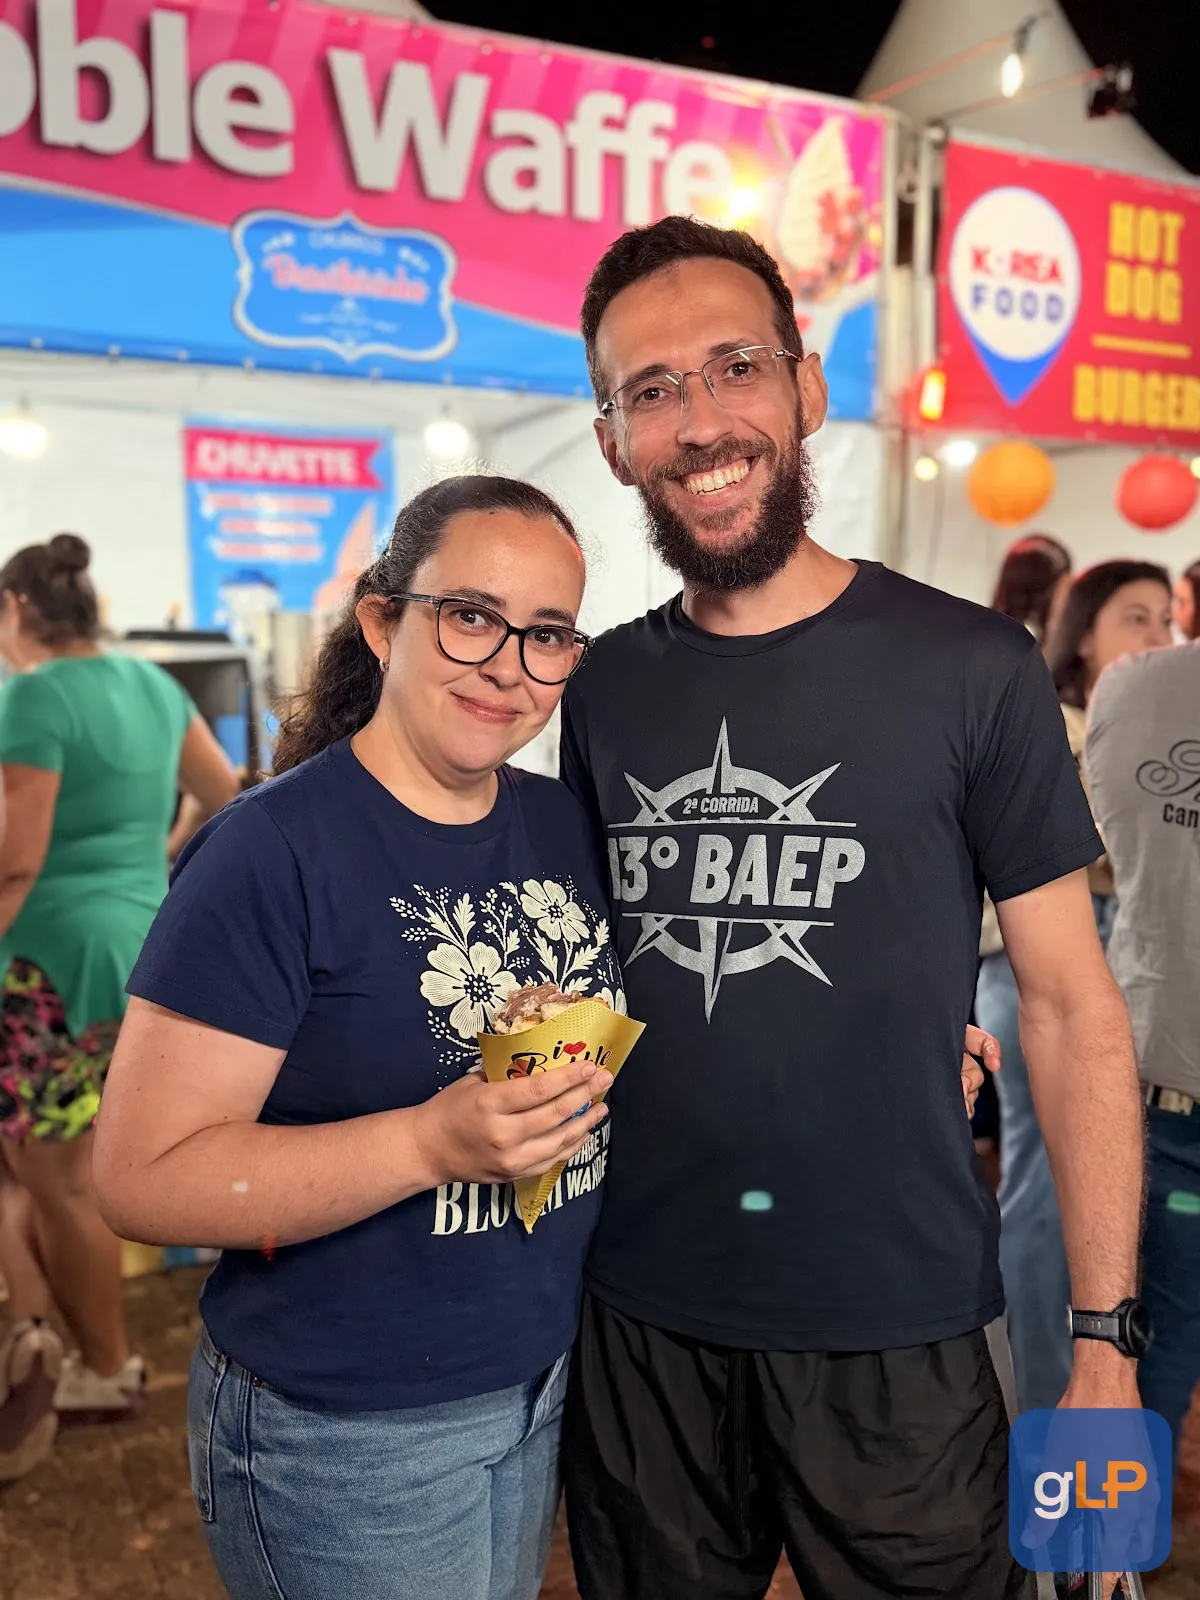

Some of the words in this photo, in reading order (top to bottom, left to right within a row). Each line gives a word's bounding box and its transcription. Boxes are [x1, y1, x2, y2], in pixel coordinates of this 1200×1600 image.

[1109, 202, 1184, 266] HOT
[971, 284, 1064, 323] FOOD
[1105, 262, 1181, 325] DOG
[700, 796, 759, 814] CORRIDA
[690, 834, 866, 909] BAEP
[431, 1174, 564, 1236] BLOM
